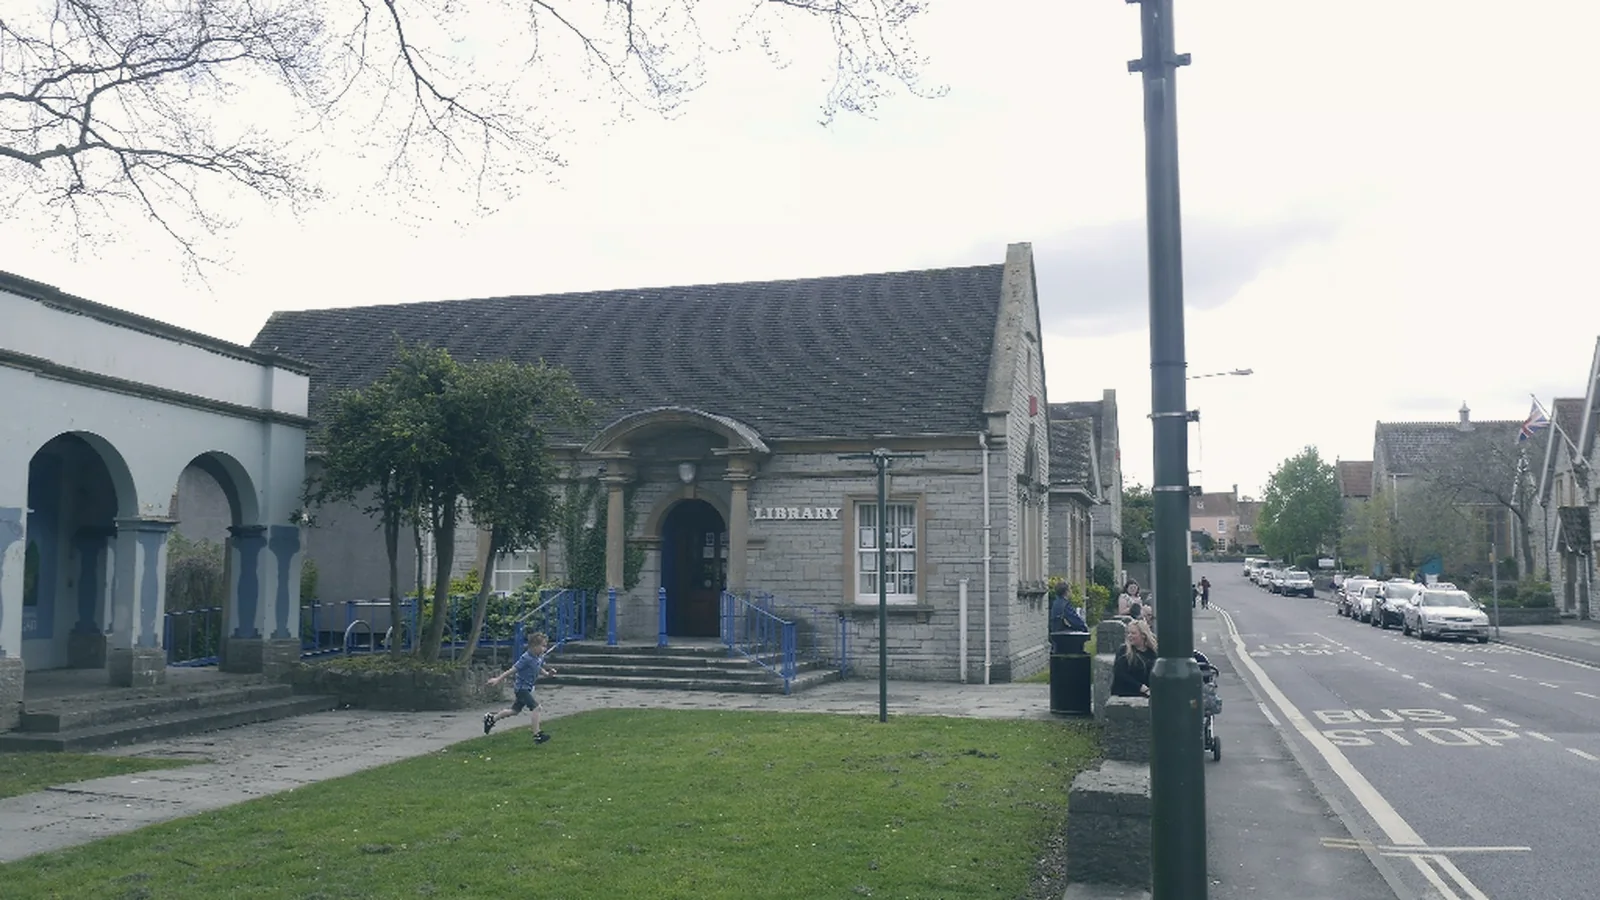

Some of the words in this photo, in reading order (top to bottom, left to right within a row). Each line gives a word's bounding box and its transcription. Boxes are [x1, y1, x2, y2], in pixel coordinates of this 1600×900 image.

[754, 507, 841, 520] LIBRARY
[1313, 708, 1457, 724] BUS
[1322, 727, 1520, 746] STOP
